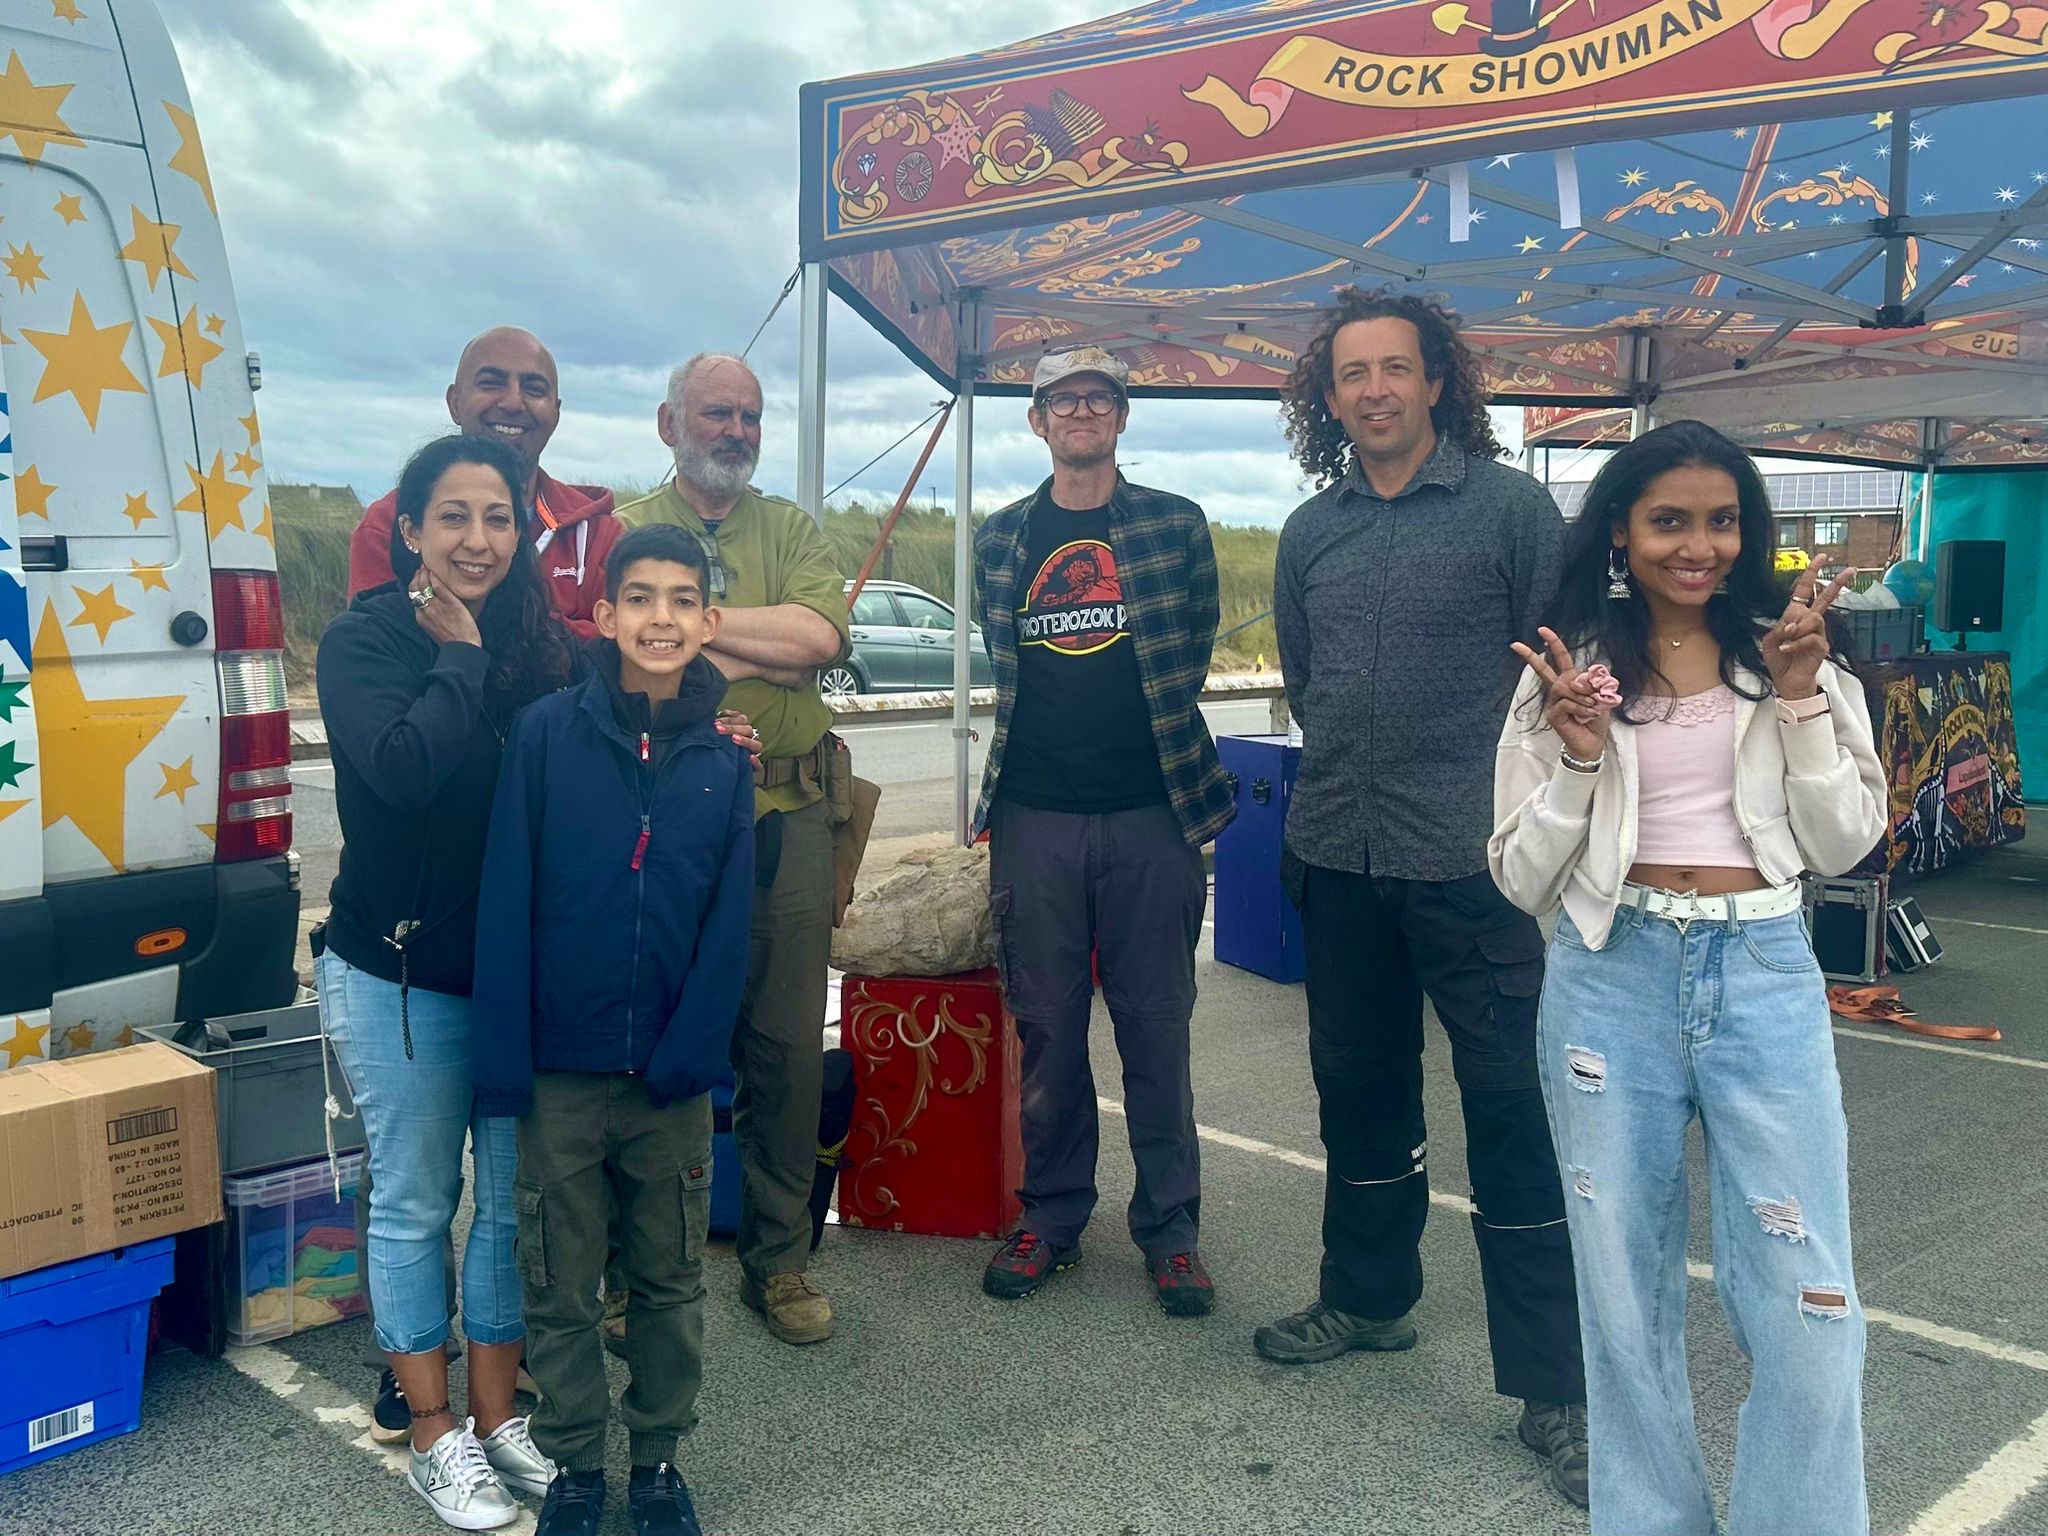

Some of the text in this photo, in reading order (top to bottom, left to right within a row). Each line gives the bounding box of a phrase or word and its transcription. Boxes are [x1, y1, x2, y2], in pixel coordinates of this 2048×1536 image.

[1324, 0, 1723, 96] ROCK SHOWMAN
[1116, 604, 1129, 629] P
[108, 1139, 180, 1162] MADE IN CHINA
[126, 1174, 146, 1185] 1277
[162, 1191, 184, 1203] ITEM
[0, 1207, 63, 1230] PTERODACT
[120, 1203, 185, 1227] PETERKIN UK
[82, 1413, 93, 1424] 25
